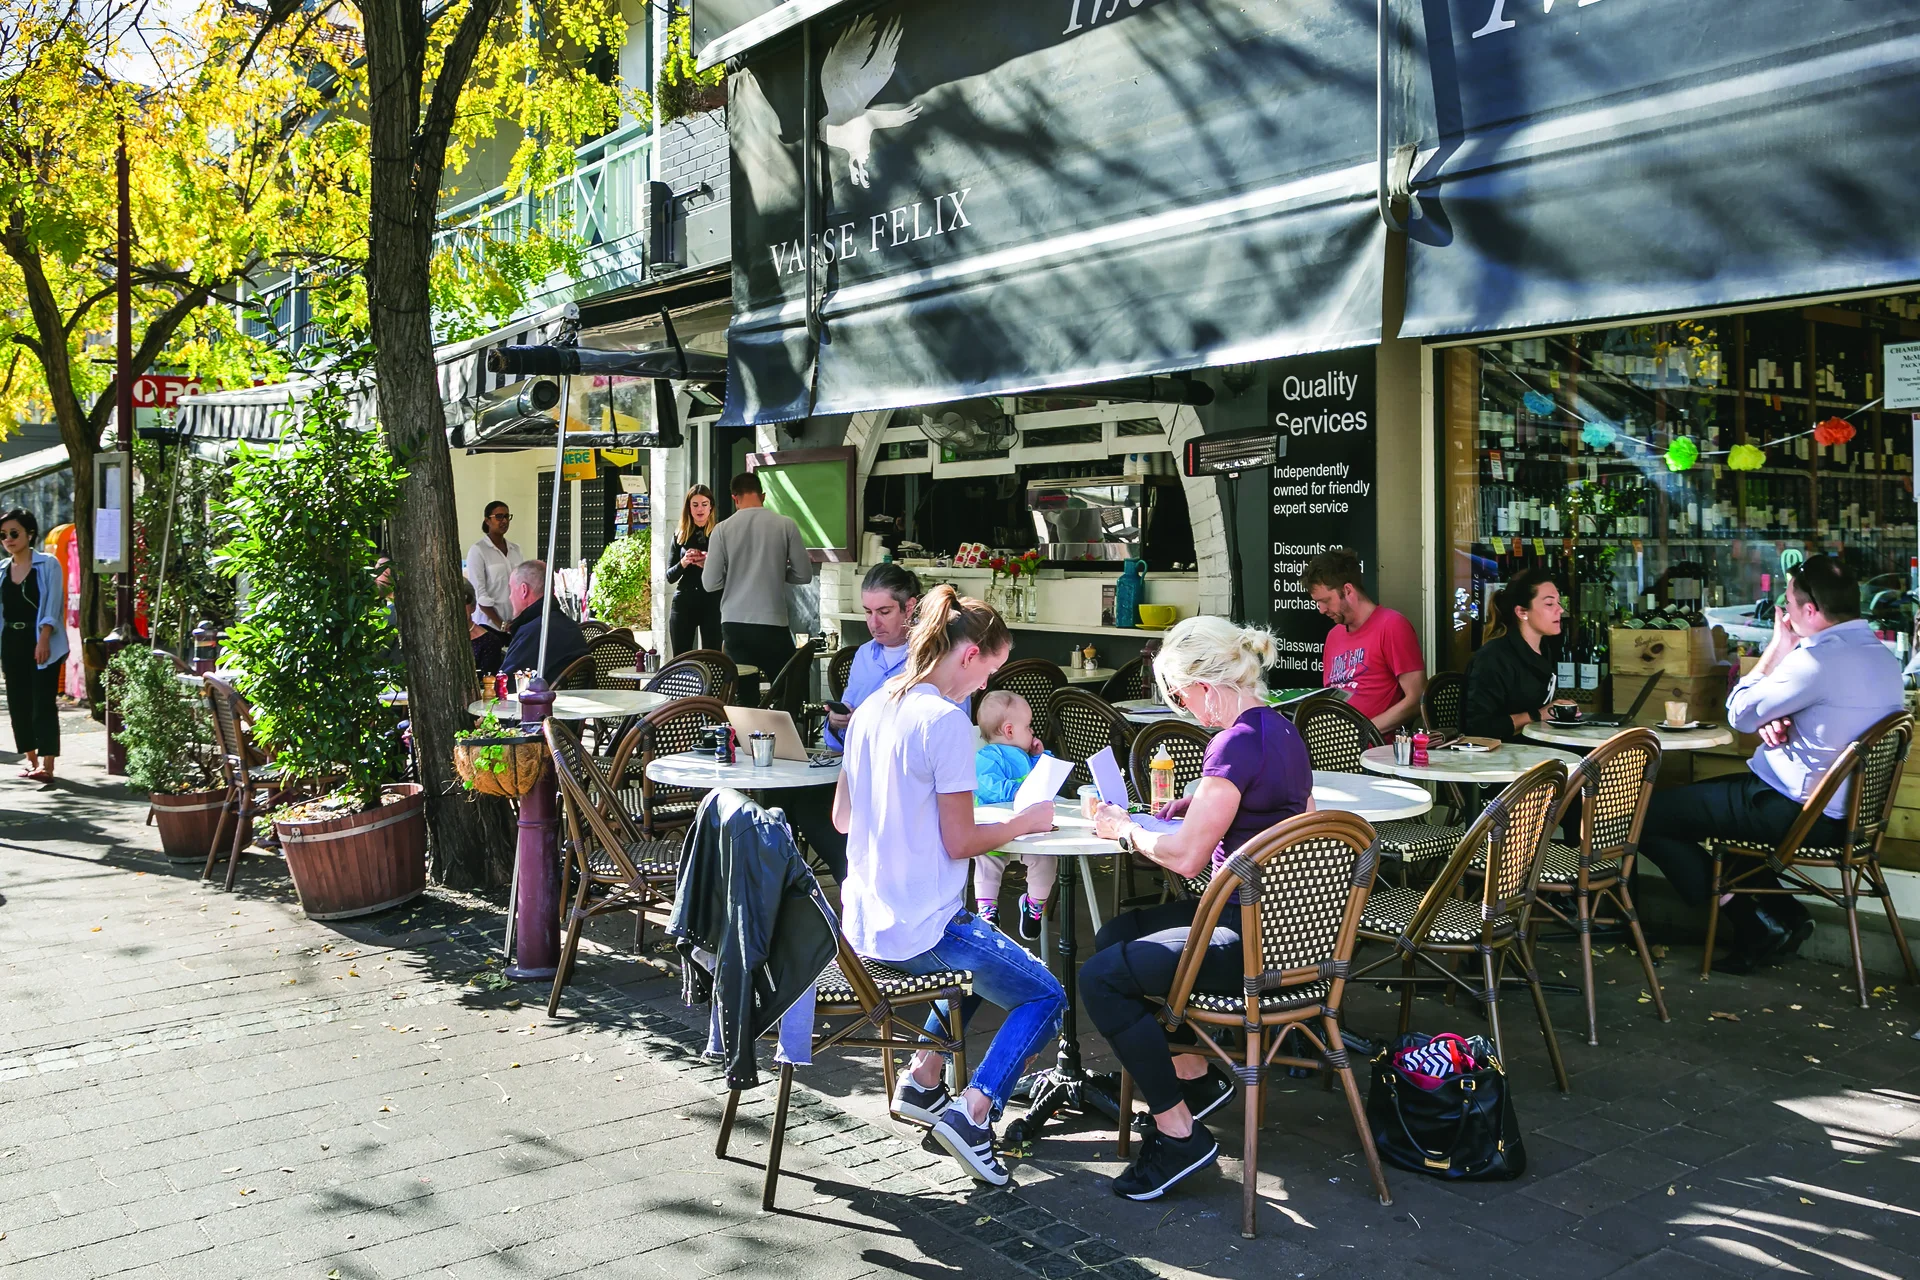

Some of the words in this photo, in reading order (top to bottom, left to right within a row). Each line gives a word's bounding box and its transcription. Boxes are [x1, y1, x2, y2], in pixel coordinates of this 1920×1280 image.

[869, 187, 972, 253] FELIX
[165, 382, 222, 402] PO
[1282, 370, 1358, 401] Quality
[1275, 408, 1368, 436] Services
[1273, 462, 1350, 481] Independently
[1273, 482, 1308, 497] owned
[1311, 481, 1326, 495] for
[1328, 480, 1370, 497] friendly
[1273, 501, 1307, 517] expert
[1309, 499, 1349, 514] service
[1273, 541, 1327, 556] Discounts
[1273, 560, 1310, 577] straigh
[1273, 578, 1281, 593] 6
[1283, 578, 1308, 593] bott
[1276, 637, 1325, 654] Glasswar
[1274, 655, 1308, 671] chilled
